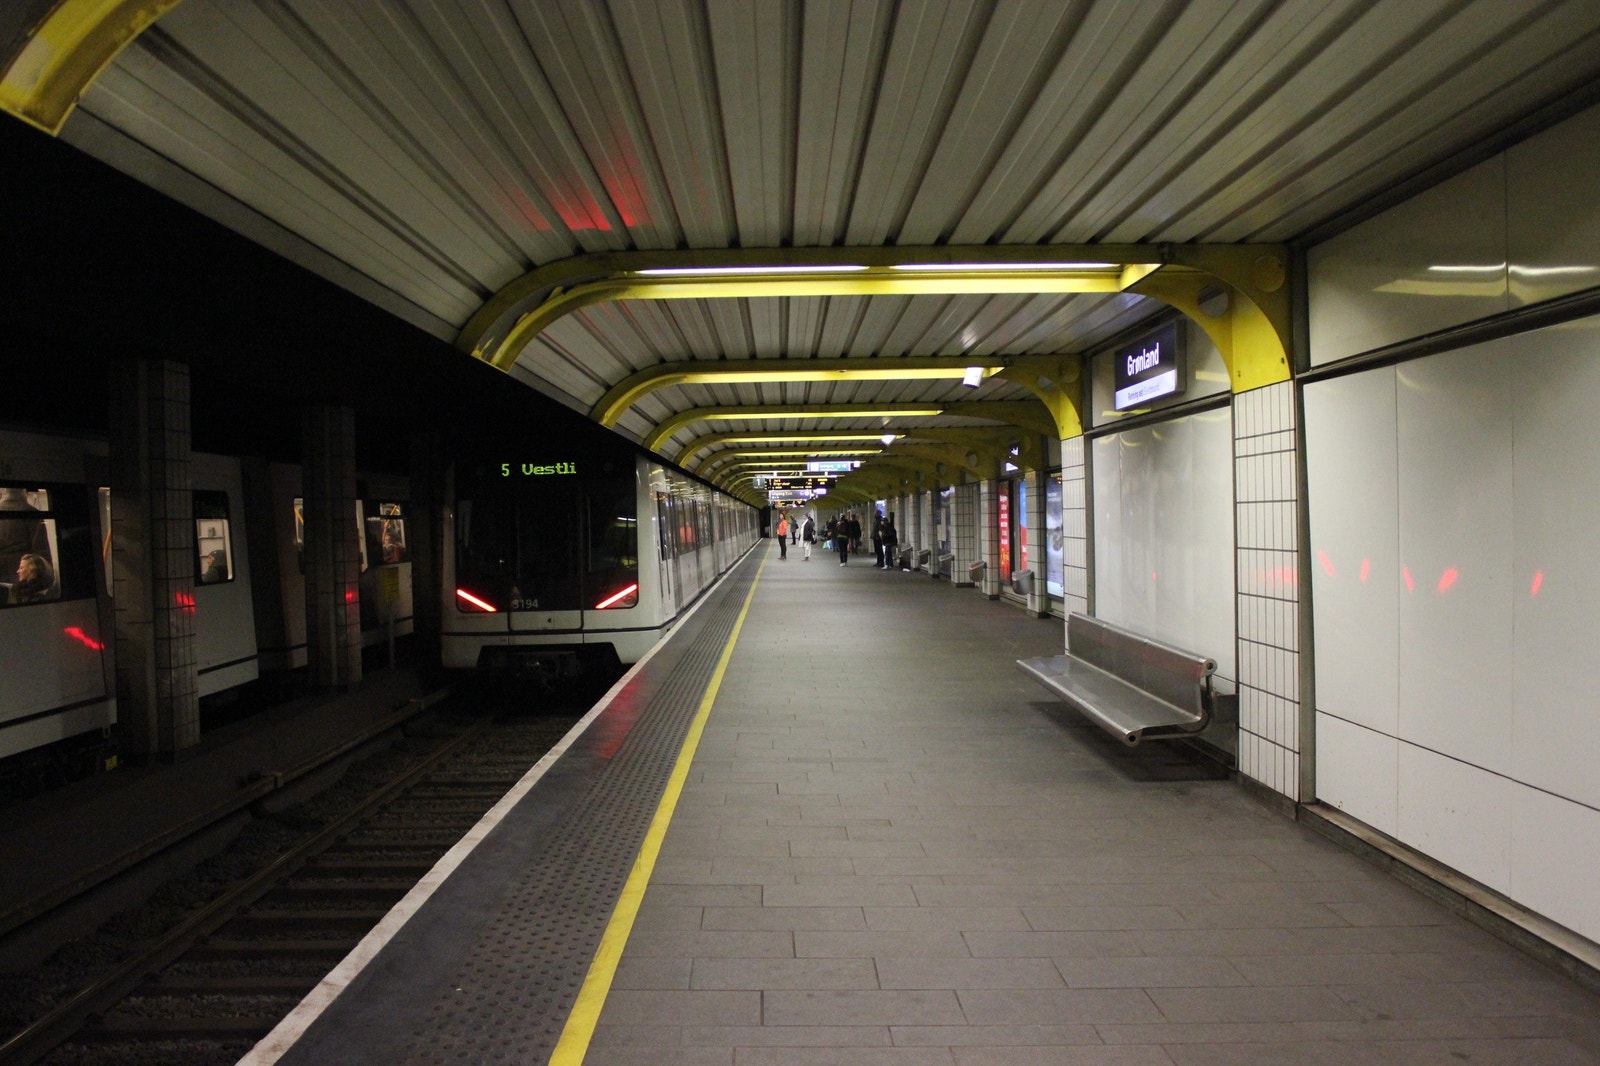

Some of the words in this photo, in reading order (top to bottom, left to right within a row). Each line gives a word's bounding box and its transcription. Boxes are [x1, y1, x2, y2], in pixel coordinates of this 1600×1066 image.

[1127, 342, 1160, 376] Grønland
[501, 463, 510, 477] 5
[521, 462, 577, 475] Vestli
